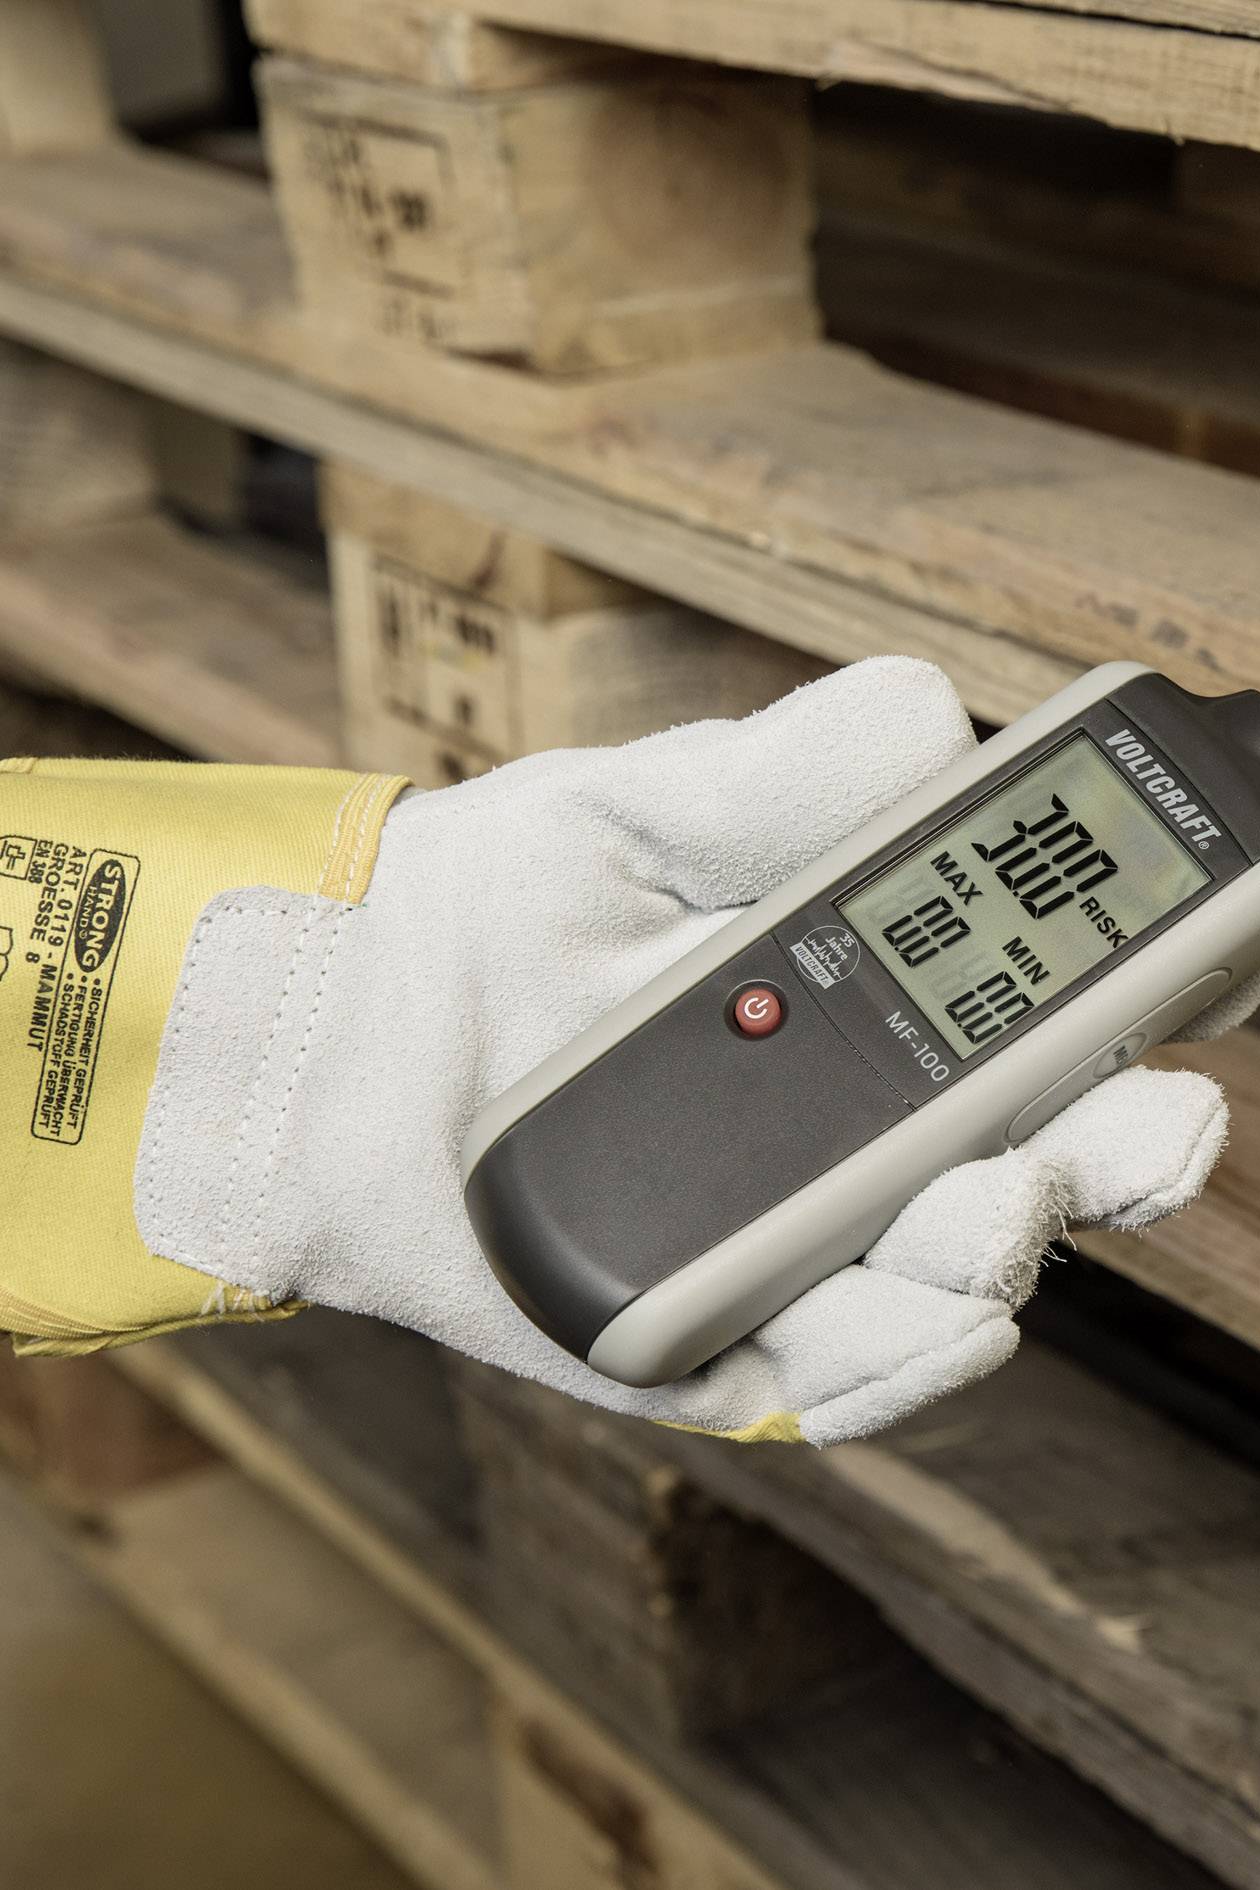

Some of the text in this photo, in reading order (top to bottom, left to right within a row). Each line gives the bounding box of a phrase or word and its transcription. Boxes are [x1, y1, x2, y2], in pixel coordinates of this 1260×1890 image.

[28, 839, 53, 885] EN 388
[60, 846, 87, 892] ART.
[929, 850, 984, 906] MAX
[25, 843, 69, 964] GROESSE 8
[47, 898, 73, 947] 0119
[81, 863, 122, 967] STRONG
[1079, 896, 1129, 949] RISK
[825, 936, 848, 961] Jahre
[840, 932, 856, 948] 35
[1001, 936, 1051, 986] MIN
[27, 963, 58, 1053] MAMMUT
[50, 983, 75, 1068] SCHADSTOFF
[64, 985, 88, 1057] FERTIGUNG
[79, 986, 103, 1066] SICHERHEIT
[885, 1010, 950, 1082] MF-100
